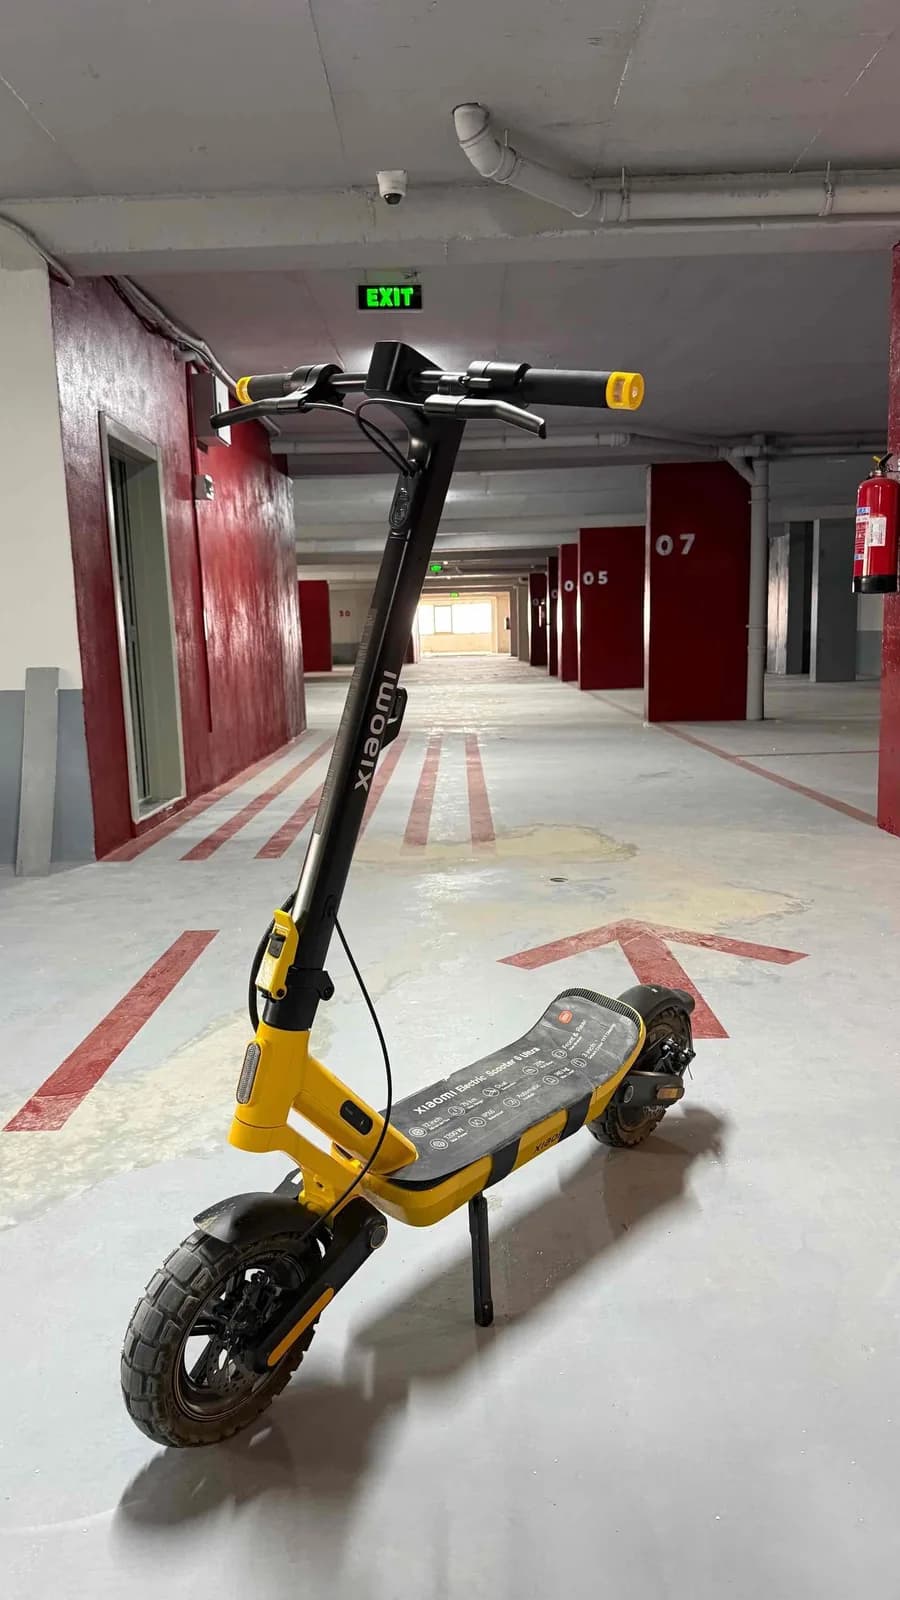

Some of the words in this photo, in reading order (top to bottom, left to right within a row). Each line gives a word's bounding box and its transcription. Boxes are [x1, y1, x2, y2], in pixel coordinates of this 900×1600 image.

[366, 287, 414, 307] EXIT
[655, 533, 696, 556] 07
[583, 570, 608, 585] 05
[354, 670, 397, 791] xiaomi
[413, 1089, 458, 1115] xiaomi
[455, 1074, 488, 1093] Electric
[485, 1059, 517, 1077] Scooter
[519, 1047, 541, 1058] Ultra
